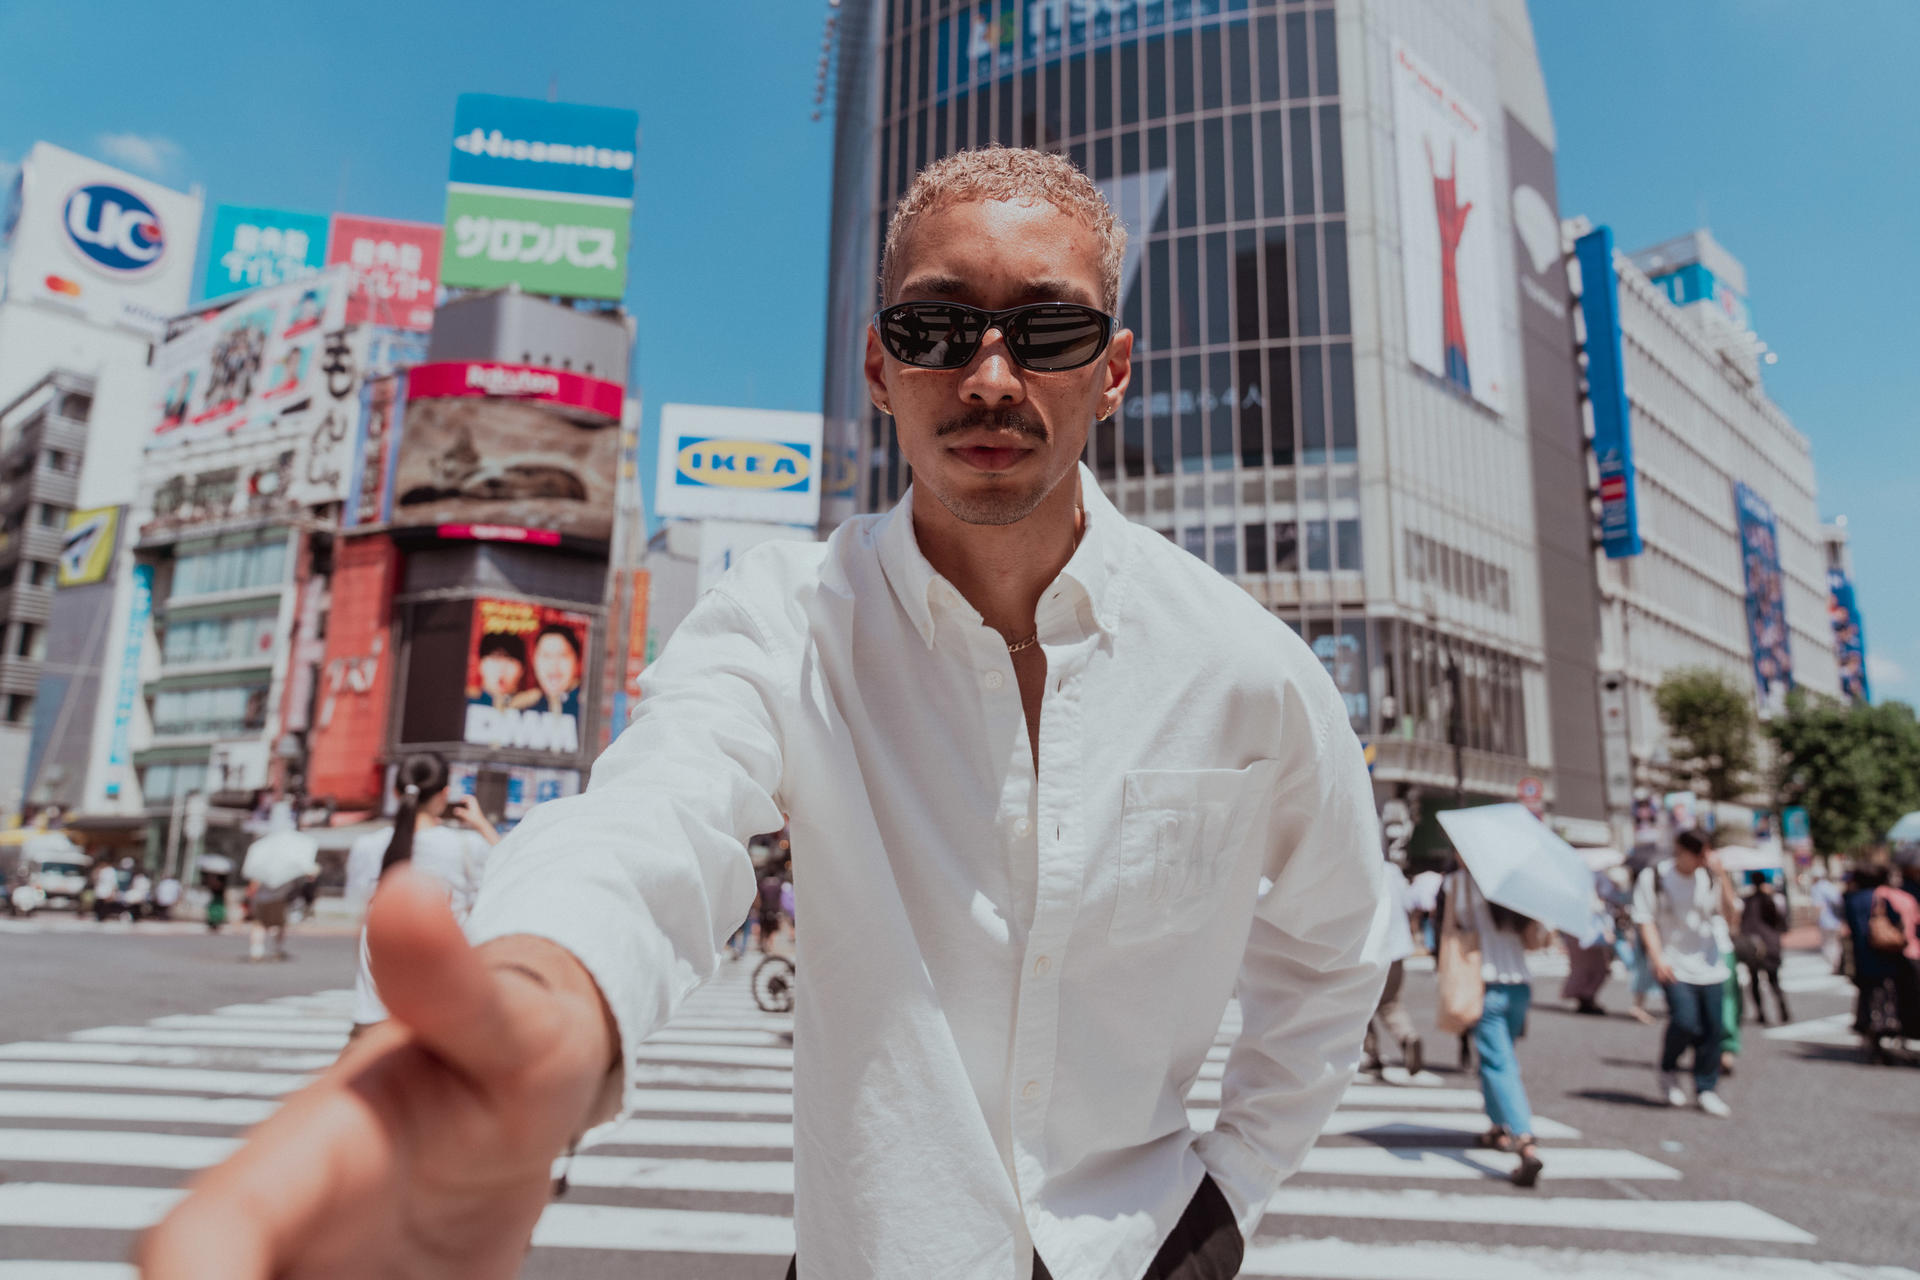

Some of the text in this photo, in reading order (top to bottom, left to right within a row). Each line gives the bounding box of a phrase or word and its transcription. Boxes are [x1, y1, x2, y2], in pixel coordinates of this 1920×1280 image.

[455, 128, 634, 171] Hisamitsu
[68, 190, 163, 263] UC
[455, 214, 618, 270] サロンパス
[691, 452, 797, 476] IKEA
